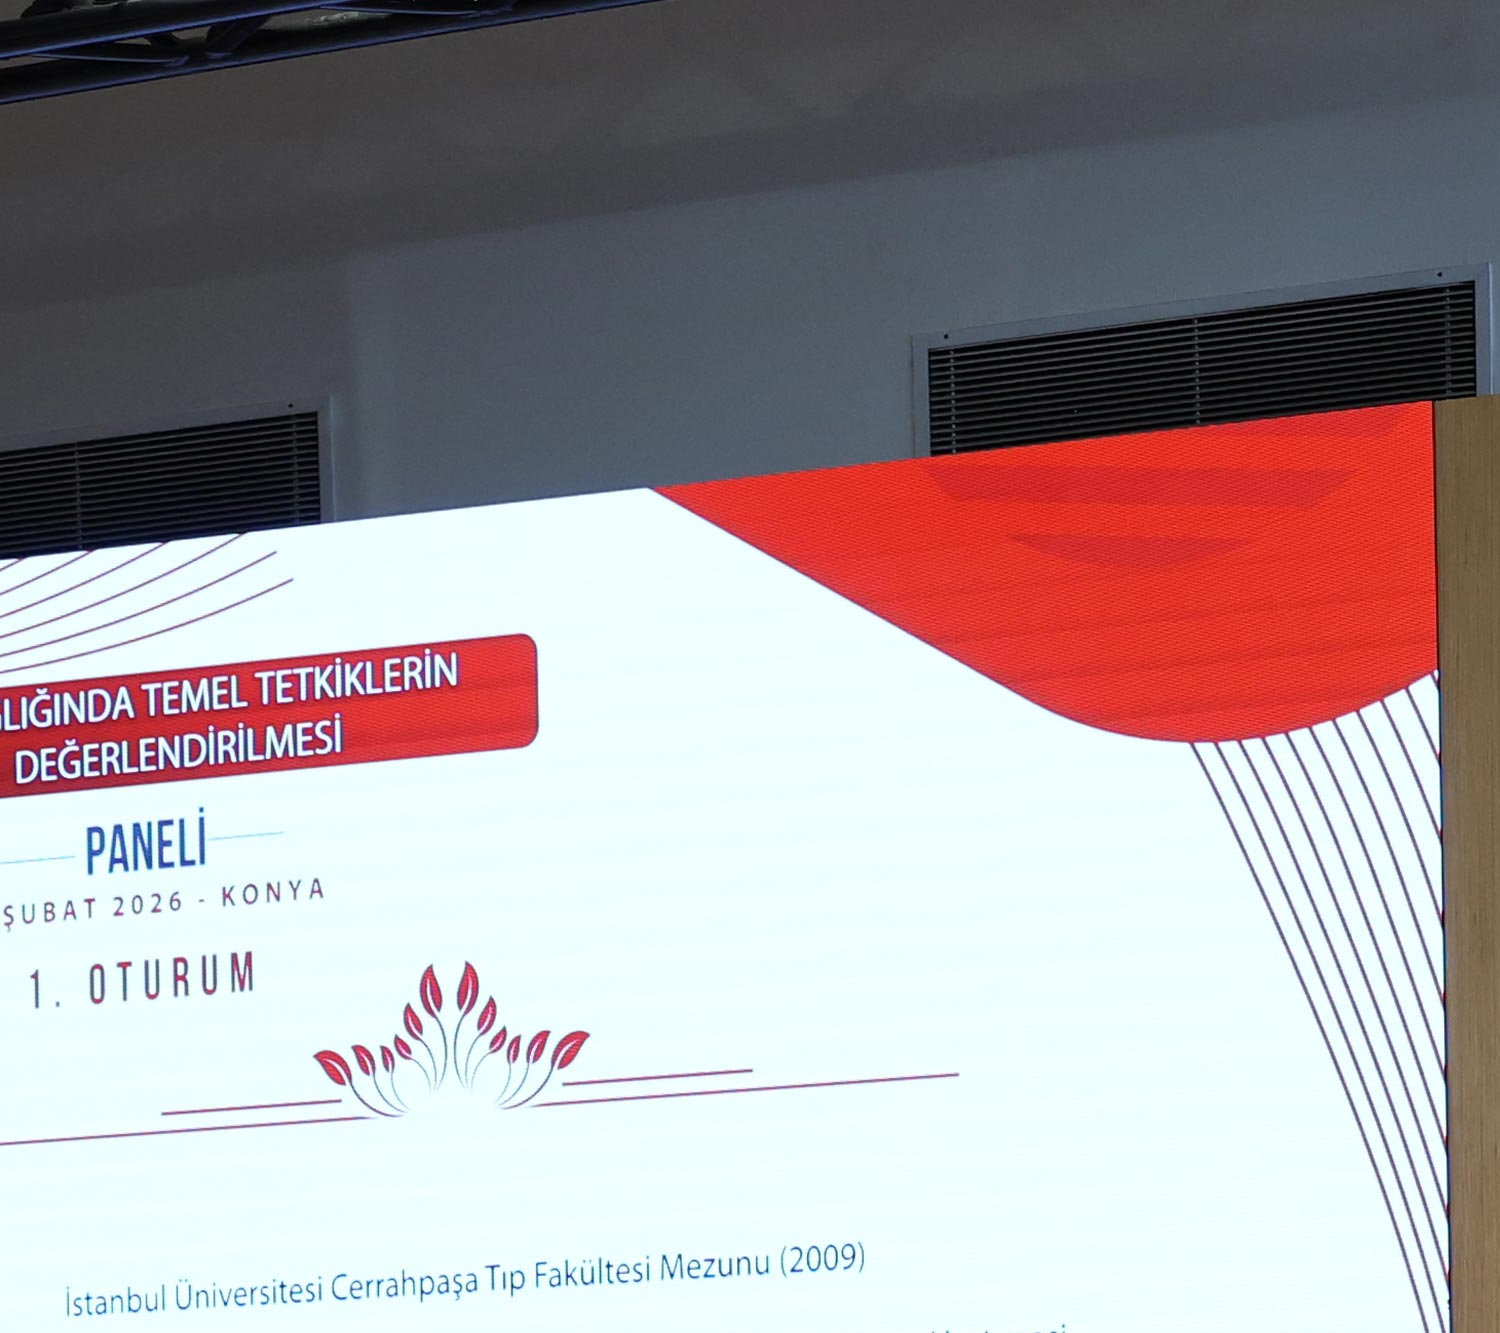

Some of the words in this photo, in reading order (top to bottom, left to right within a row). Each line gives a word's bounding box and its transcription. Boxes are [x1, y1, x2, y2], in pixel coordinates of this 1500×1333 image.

[141, 675, 248, 716] TEMEL
[255, 649, 457, 704] TETKİKLERİN
[14, 713, 344, 786] DEĞERLENDİRİLMESİ
[87, 807, 205, 875] PANELİ
[3, 898, 95, 932] ŞUBAT
[113, 891, 181, 916] 2026
[222, 878, 323, 907] KONYA
[30, 969, 60, 1009] 1.
[90, 951, 253, 1004] OTURUM
[67, 1285, 165, 1316] İstanbul
[176, 1276, 322, 1310] Üniversitesi
[332, 1269, 478, 1303] Cerrahpaşa
[485, 1265, 525, 1296] Tıp
[536, 1256, 650, 1288] Fakültesi
[661, 1253, 769, 1280] Mezunu
[781, 1242, 864, 1277] (2009)
